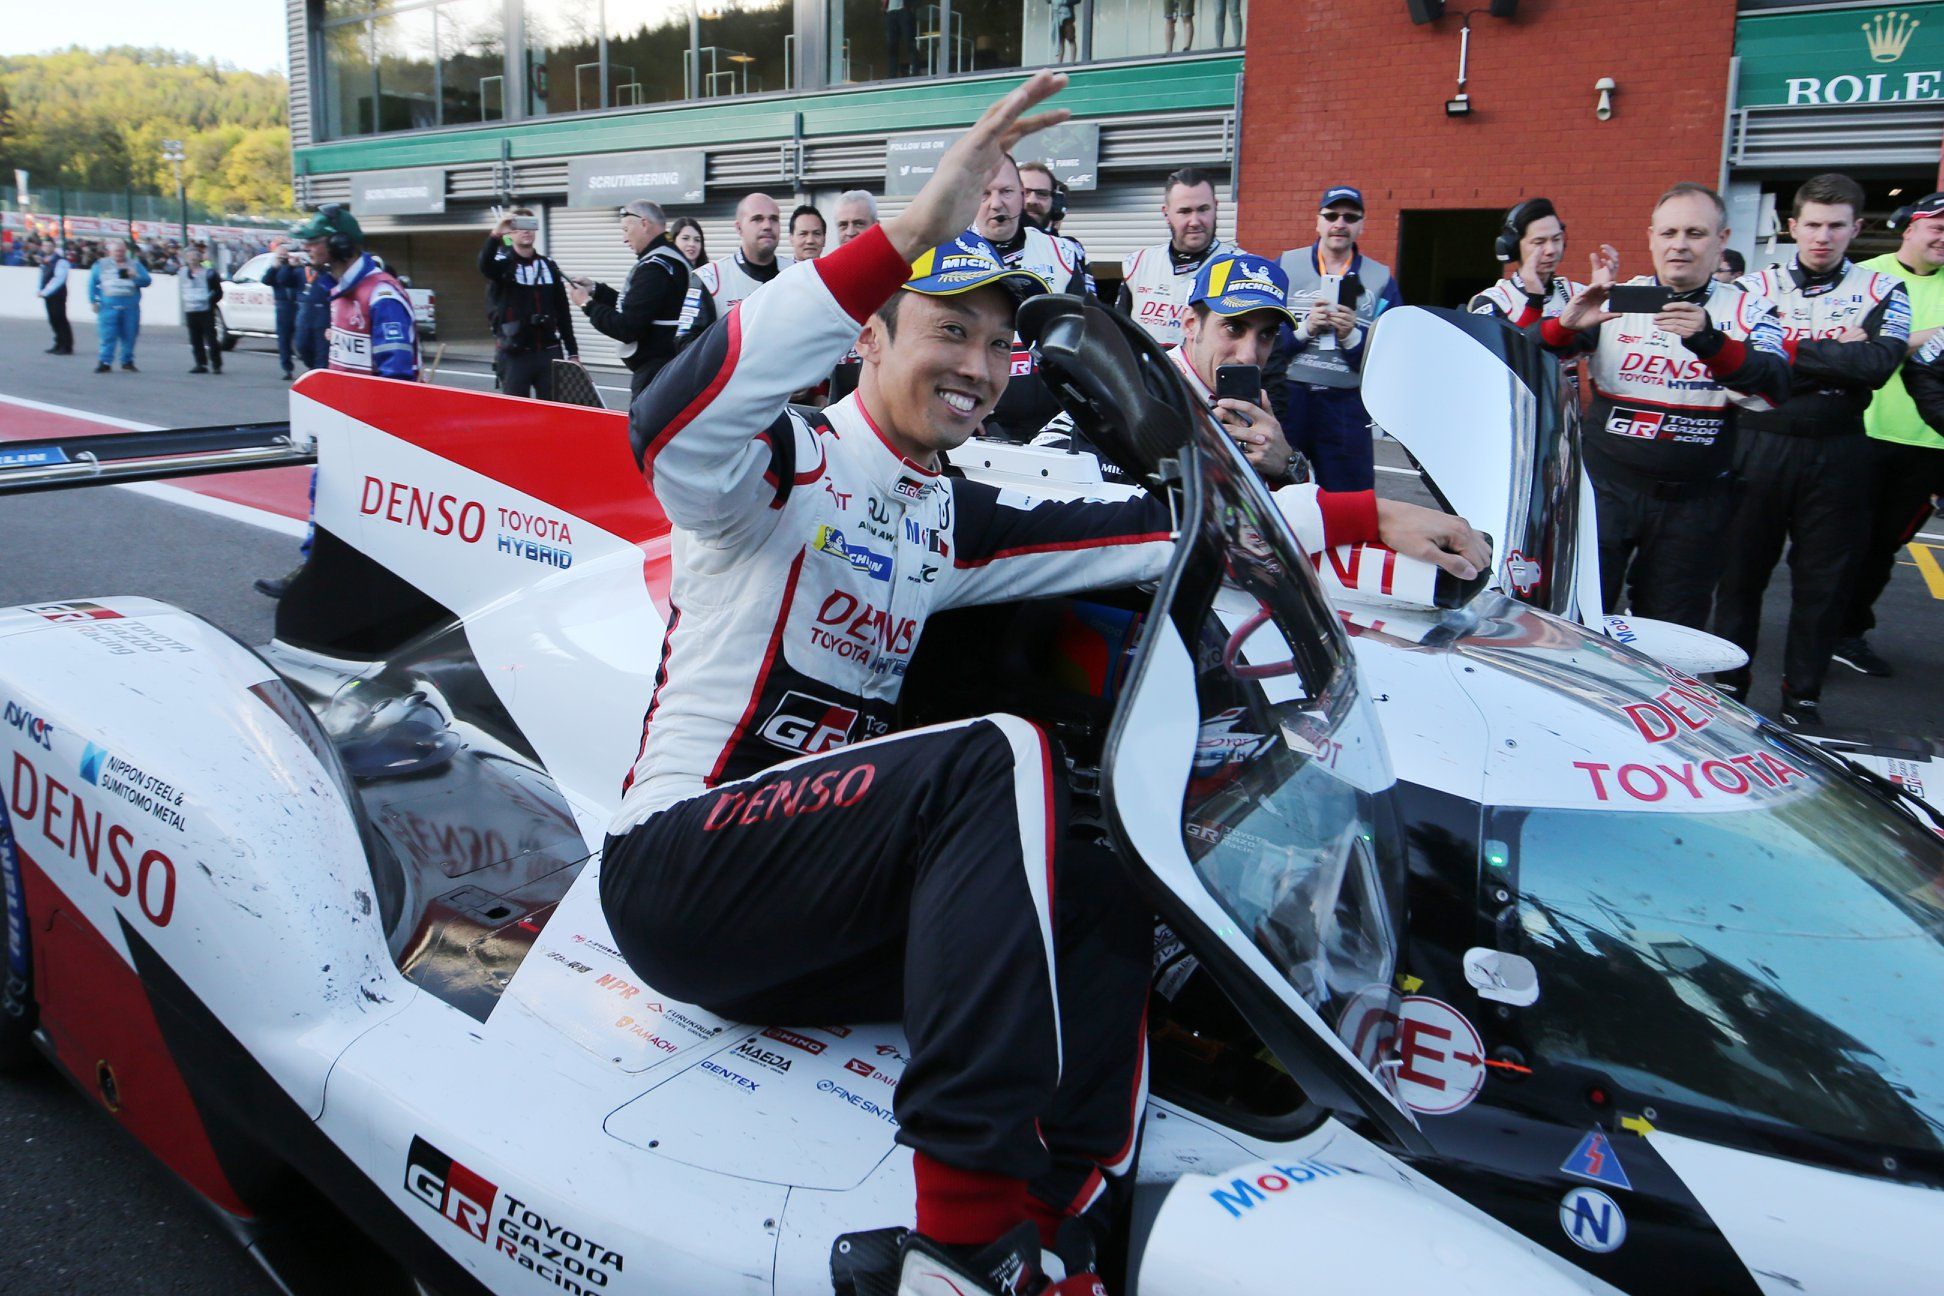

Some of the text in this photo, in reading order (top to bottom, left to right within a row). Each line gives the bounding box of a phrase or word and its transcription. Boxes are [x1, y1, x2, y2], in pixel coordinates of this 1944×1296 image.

[1785, 70, 1942, 105] ROLE
[889, 140, 945, 151] FOLLOW US ON
[588, 171, 679, 189] SCRUTINEERING
[1227, 281, 1286, 301] MICHELIN
[1619, 372, 1665, 386] TOYOTA
[1608, 414, 1657, 438] GR
[1660, 424, 1719, 435] GAZOO
[1667, 414, 1725, 427] TOYOTA
[894, 480, 919, 498] GR
[360, 475, 486, 544] DENSO
[498, 507, 573, 545] TOYOTA
[497, 533, 573, 570] HYBRID
[23, 602, 99, 623] GR
[66, 624, 136, 656] Racing
[95, 622, 163, 653] GAZOO
[122, 620, 195, 654] TOYOTA
[811, 627, 871, 666] TOYOTA
[761, 710, 850, 753] GR
[106, 756, 185, 807] NIPPON STEEL &
[1572, 751, 1810, 802] TOYOTA
[100, 774, 186, 832] SUMITOMO METAL
[703, 763, 877, 831] DENSO
[11, 750, 177, 928] DENSO
[595, 973, 641, 1000] NPR
[627, 1023, 679, 1054] TAMACHI
[667, 1009, 716, 1037] FURUKAWA
[735, 1043, 793, 1072] MAEDA
[780, 1030, 821, 1052] HINO
[1397, 1017, 1453, 1092] E
[700, 1060, 760, 1091] GENTEX
[406, 1161, 490, 1241] GR
[1210, 1159, 1342, 1219] Mobil
[504, 1193, 624, 1273] TOYOTA
[1573, 1195, 1611, 1245] N
[498, 1217, 609, 1288] GAZOO
